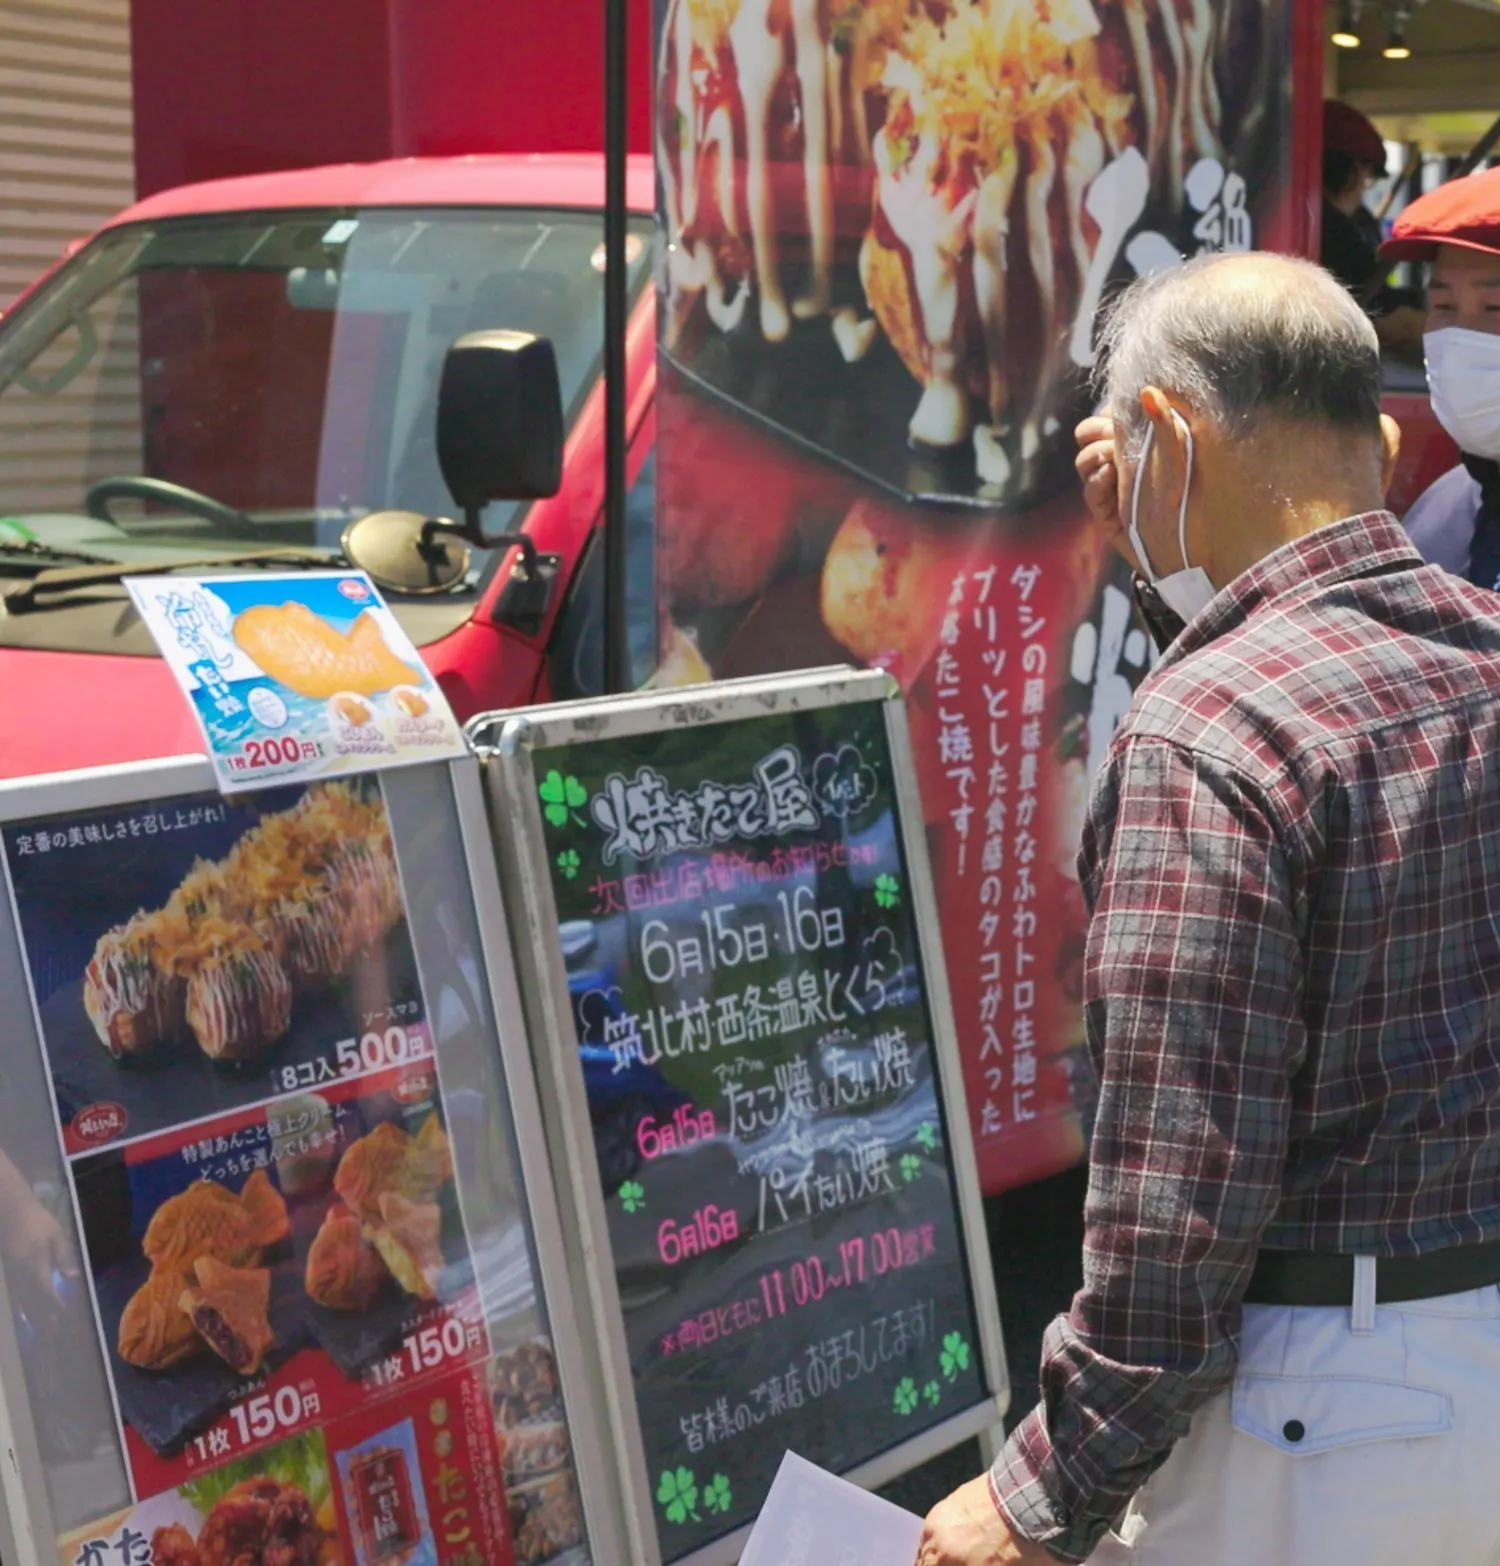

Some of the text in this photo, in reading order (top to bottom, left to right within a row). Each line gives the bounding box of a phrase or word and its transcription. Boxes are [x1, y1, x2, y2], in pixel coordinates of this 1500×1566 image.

[15, 804, 227, 857] 定番の美味しさを召し上がれ!
[593, 745, 818, 862] 焼きたて屋
[637, 1103, 716, 1159] 6月15日
[658, 1203, 739, 1265] 6月16日
